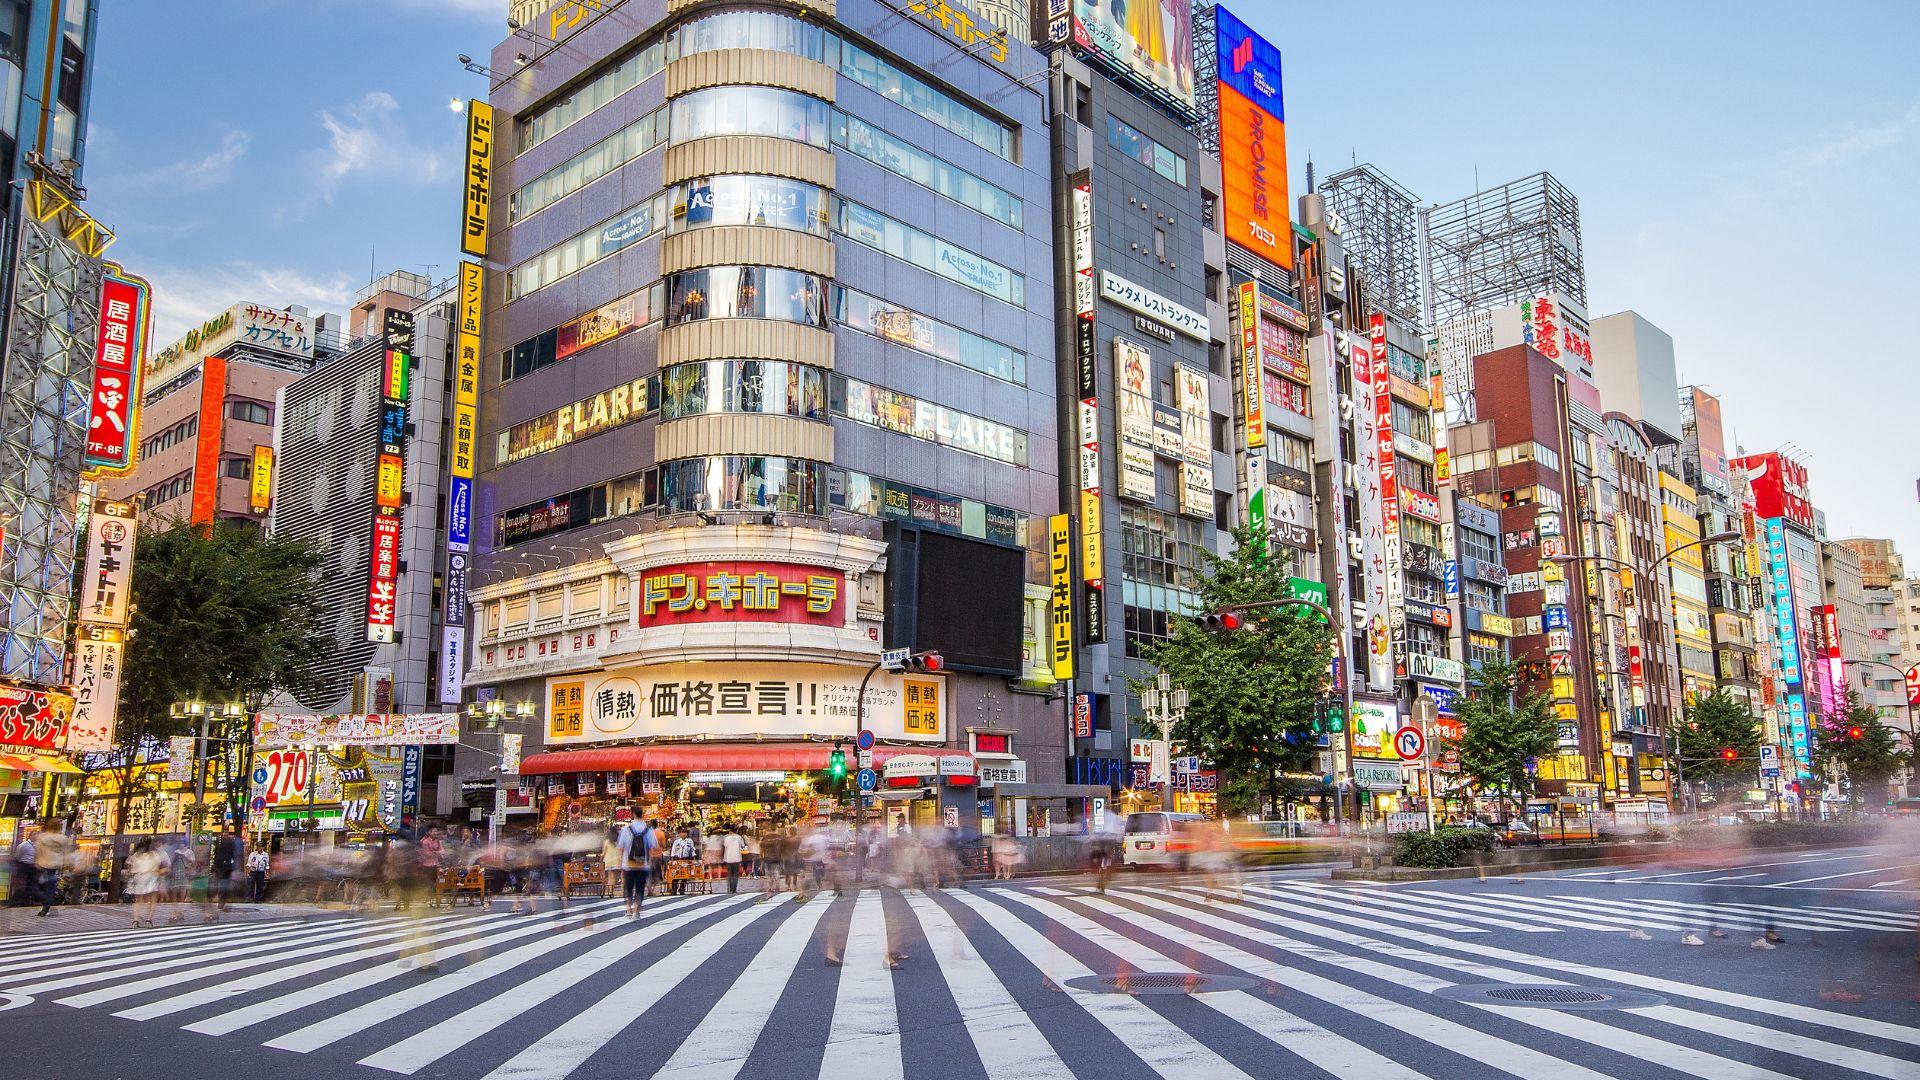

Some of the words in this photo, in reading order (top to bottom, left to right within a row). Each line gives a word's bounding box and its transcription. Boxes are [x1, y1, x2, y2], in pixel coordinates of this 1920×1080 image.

[1249, 107, 1268, 221] PROMISE
[1249, 221, 1277, 249] プロミス
[463, 269, 480, 332] ブランド品
[1106, 278, 1142, 303] エンタメ
[1145, 295, 1208, 332] レストランタワー
[1307, 284, 1318, 323] 水上ビル
[102, 299, 130, 365] 居酒屋
[245, 305, 305, 333] サウナ&
[1139, 318, 1176, 341] SQUARE
[245, 322, 313, 352] カプセル
[460, 346, 476, 394] 貴金属
[91, 377, 124, 433] つぼ八
[556, 379, 647, 440] FLARE
[382, 424, 394, 444] Elle
[848, 407, 888, 428] PHOTO
[890, 418, 936, 442] STUDIO
[914, 400, 1015, 463] FLARE
[456, 413, 472, 471] 高額買取
[508, 445, 535, 462] PHOTO
[536, 433, 573, 451] STUDIO
[104, 504, 130, 517] 6F
[254, 506, 265, 514] 6F
[382, 507, 395, 515] 6F
[886, 488, 909, 509] 販売
[913, 498, 936, 510] ブランド
[939, 504, 961, 518] 時計
[1086, 498, 1096, 569] アラビアンロック
[377, 534, 393, 578] 居楽屋
[1445, 562, 1457, 594] 747
[1052, 531, 1072, 661] ドン・キホーテ
[1088, 593, 1098, 637] ミステリアス
[90, 628, 115, 641] 5F
[448, 641, 457, 683] 写真スタジオ
[446, 686, 457, 696] 5F
[554, 686, 582, 706] 情熱
[595, 690, 637, 721] 情熱
[649, 680, 817, 717] 価格宣言!!
[907, 684, 936, 706] 情熱
[553, 712, 582, 735] 価格
[907, 709, 936, 731] 価格
[1077, 704, 1090, 738] ダイコク
[1761, 747, 1772, 760] P
[266, 751, 307, 804] 270
[339, 767, 366, 781] カラオケ
[403, 749, 419, 804] カラオケ
[982, 767, 1024, 783] 価格宣言!!
[340, 799, 370, 821] 747
[384, 780, 398, 826] カラオケ
[402, 804, 415, 814] B1
